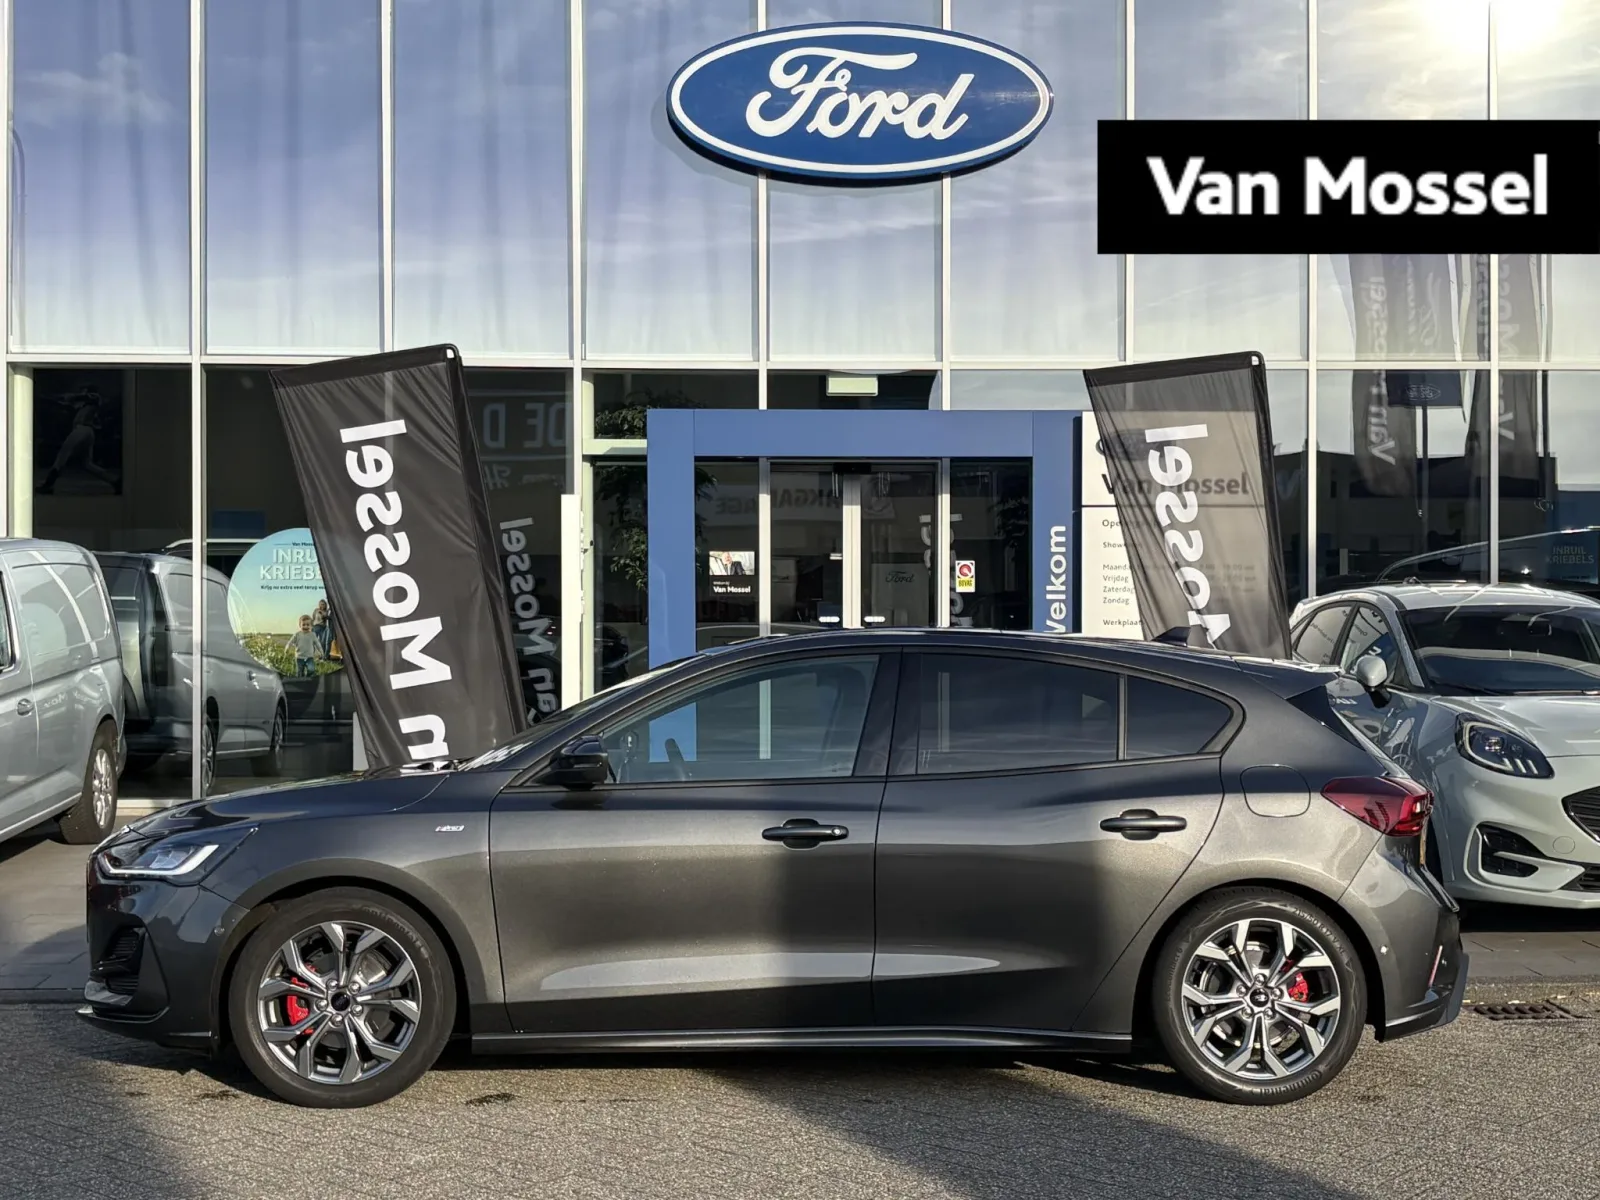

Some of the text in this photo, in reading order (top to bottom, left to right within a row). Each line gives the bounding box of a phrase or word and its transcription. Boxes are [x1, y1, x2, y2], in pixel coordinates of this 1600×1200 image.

[746, 47, 975, 140] Ford
[1159, 471, 1249, 495] ossel
[273, 549, 318, 563] INRU
[260, 564, 323, 580] KRIEB
[1102, 574, 1129, 584] Vrijdag
[1102, 597, 1130, 605] Zondag
